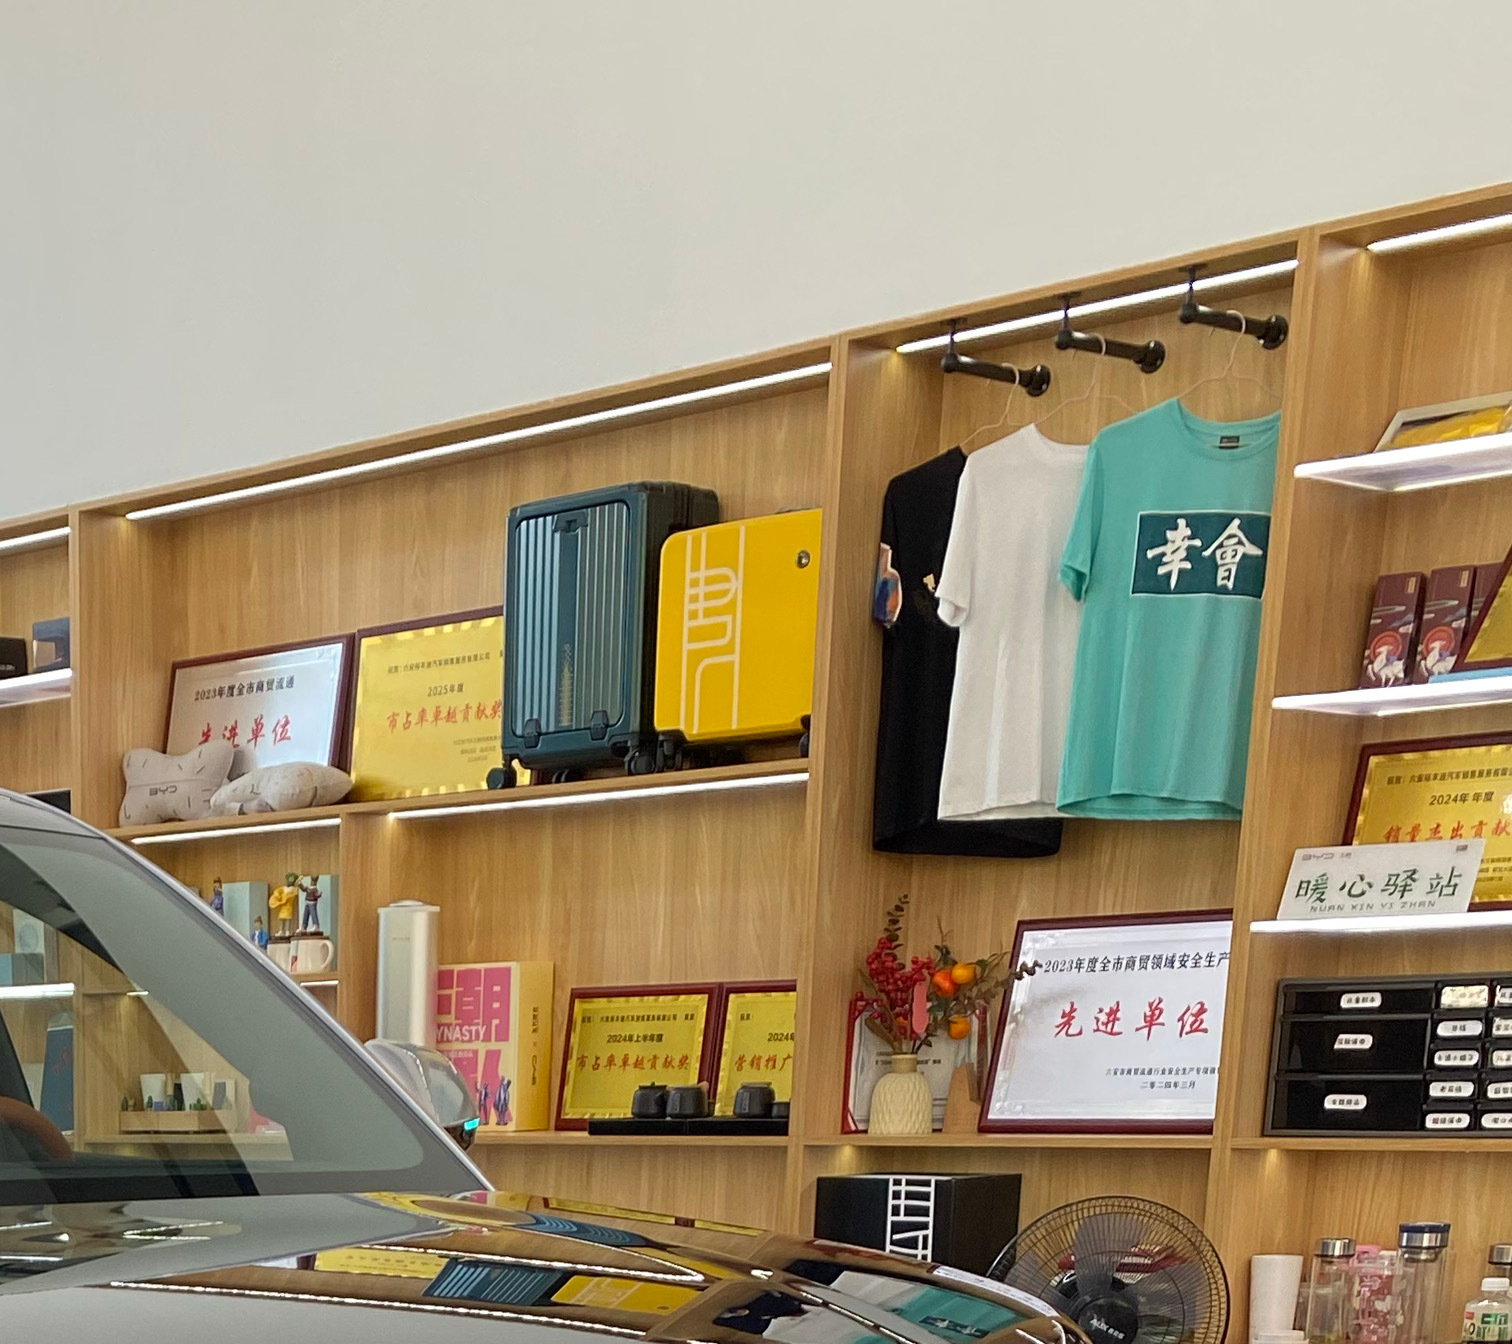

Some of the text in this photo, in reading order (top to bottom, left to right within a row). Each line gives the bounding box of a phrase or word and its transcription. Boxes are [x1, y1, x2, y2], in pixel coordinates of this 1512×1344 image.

[1147, 518, 1264, 592] 幸會
[194, 675, 295, 701] 2023年度全市商贸流通
[427, 682, 465, 697] 2025年度
[149, 784, 178, 796] BYD
[1295, 866, 1463, 903] 暖心驿站
[1310, 903, 1345, 912] NUAN
[1350, 903, 1374, 911] XIN
[1400, 900, 1436, 908] ZHAN
[1043, 952, 1231, 974] 2023年度全市商贸领域安全生产
[1054, 996, 1209, 1042] 先进单位
[437, 1025, 487, 1042] YNASTY
